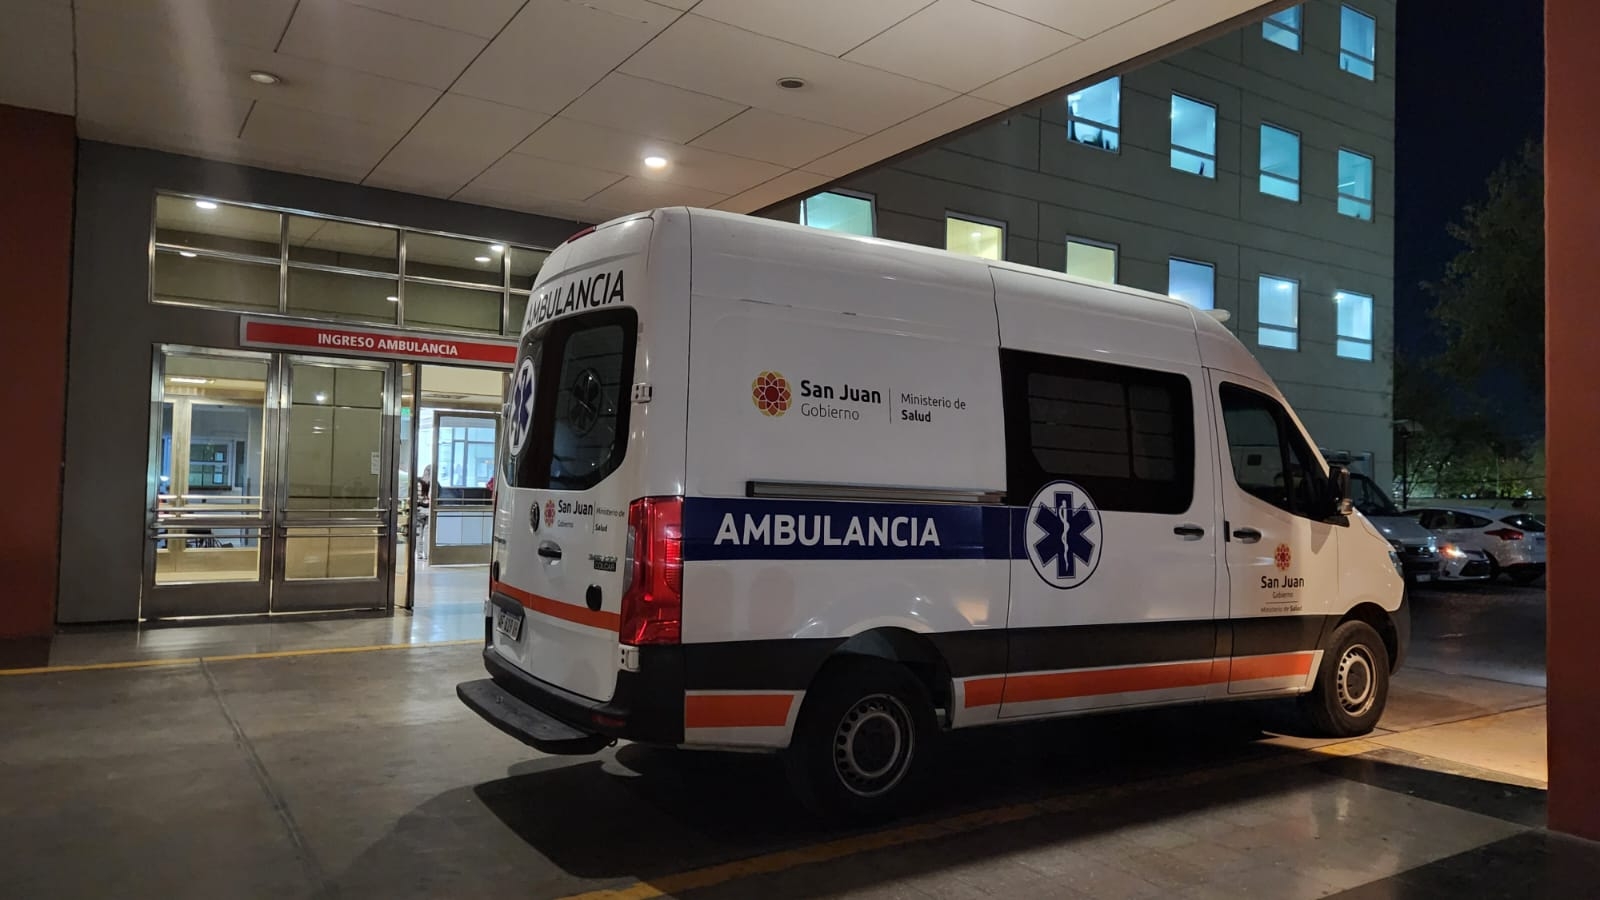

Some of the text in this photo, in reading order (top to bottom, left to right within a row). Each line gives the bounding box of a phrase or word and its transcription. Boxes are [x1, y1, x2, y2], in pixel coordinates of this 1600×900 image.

[527, 270, 624, 327] AMBULANCIA
[318, 333, 458, 356] INGRESO AMBULANCIA
[800, 380, 881, 404] San Juan
[901, 393, 966, 410] Ministerio de
[801, 403, 860, 421] Gobierno
[901, 410, 931, 422] Salud
[558, 500, 593, 516] San Juan
[713, 513, 941, 547] AMBULANCIA
[1260, 575, 1305, 589] San Juan
